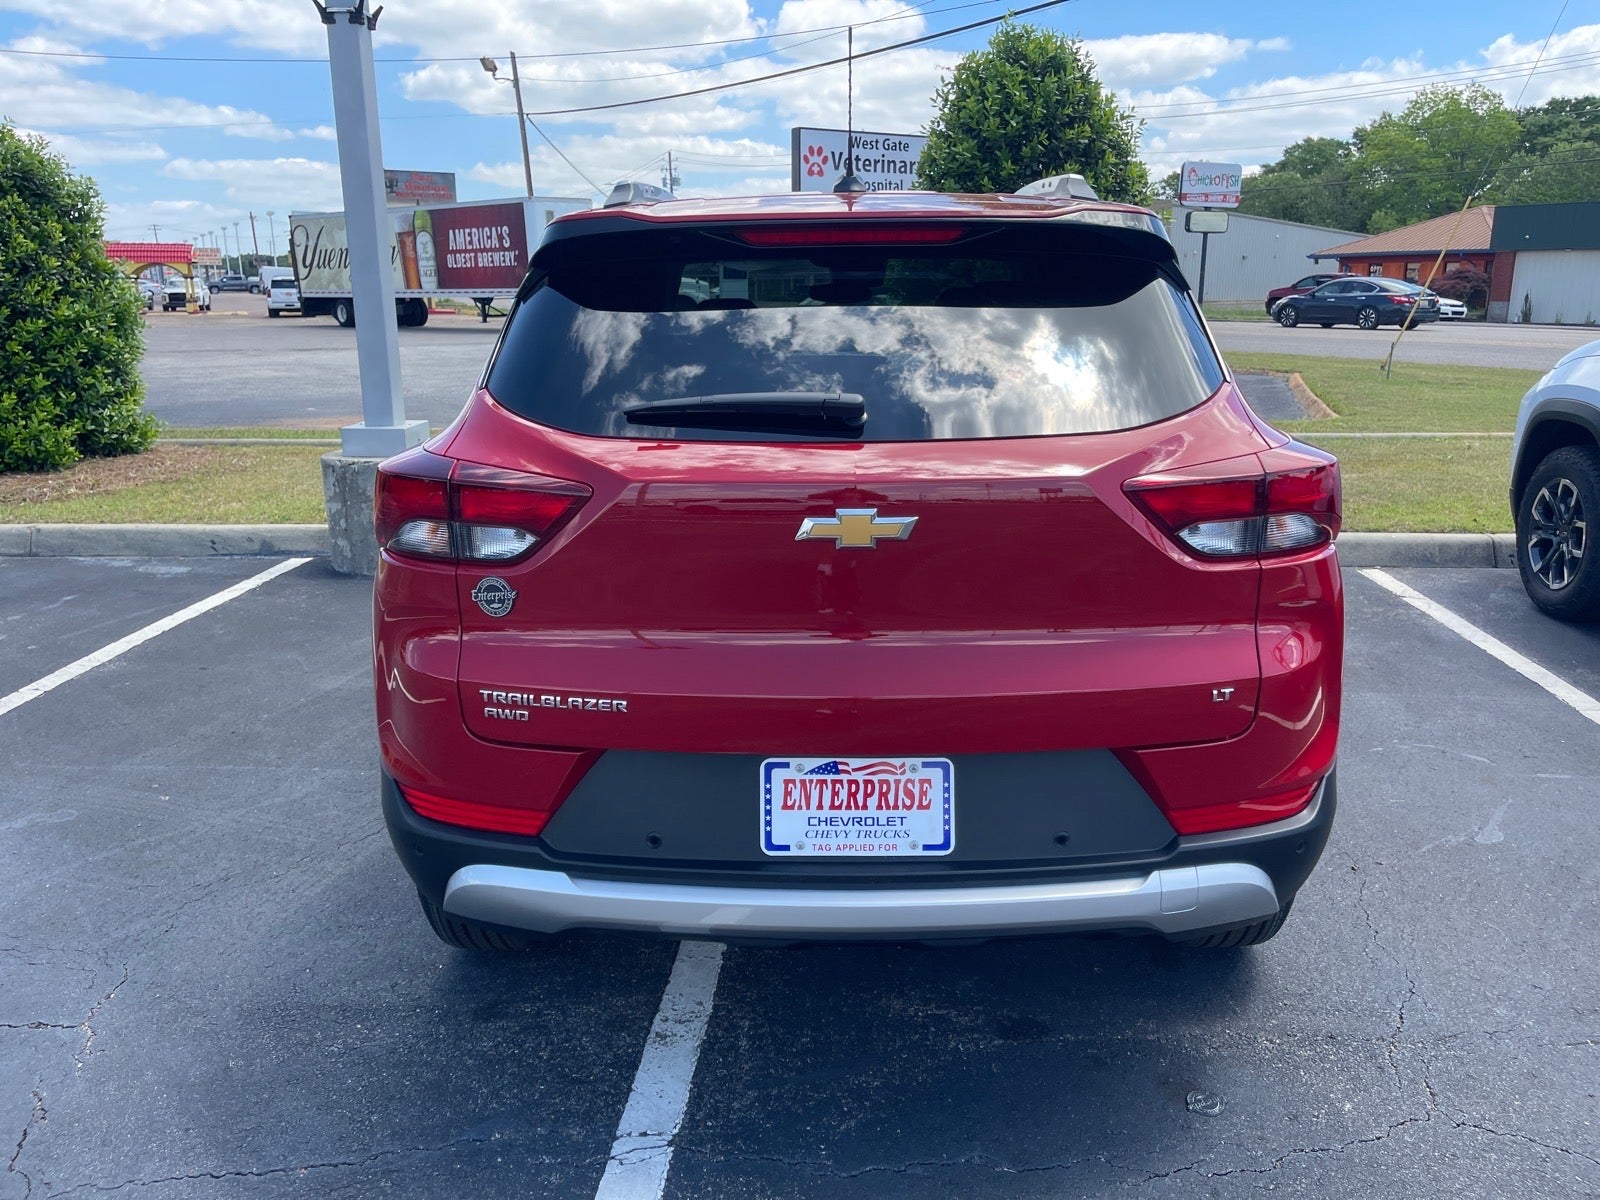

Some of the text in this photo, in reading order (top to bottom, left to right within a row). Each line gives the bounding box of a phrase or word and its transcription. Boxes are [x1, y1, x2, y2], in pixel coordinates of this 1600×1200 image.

[850, 136, 910, 152] West Gate
[831, 151, 919, 175] Veterinar
[863, 179, 903, 192] ospital
[449, 225, 511, 250] AMERICA'S
[447, 252, 475, 268] OLDEST
[471, 589, 517, 602] Enterprise
[479, 689, 628, 713] TRAILBLAZER
[1212, 688, 1235, 702] LT
[484, 707, 529, 721] AWD
[781, 777, 932, 811] ENTERPRISE
[807, 816, 907, 827] CHEVROLET
[804, 829, 911, 839] CHEVY TRUCKS
[812, 843, 898, 852] TAG APPLIED FOR
